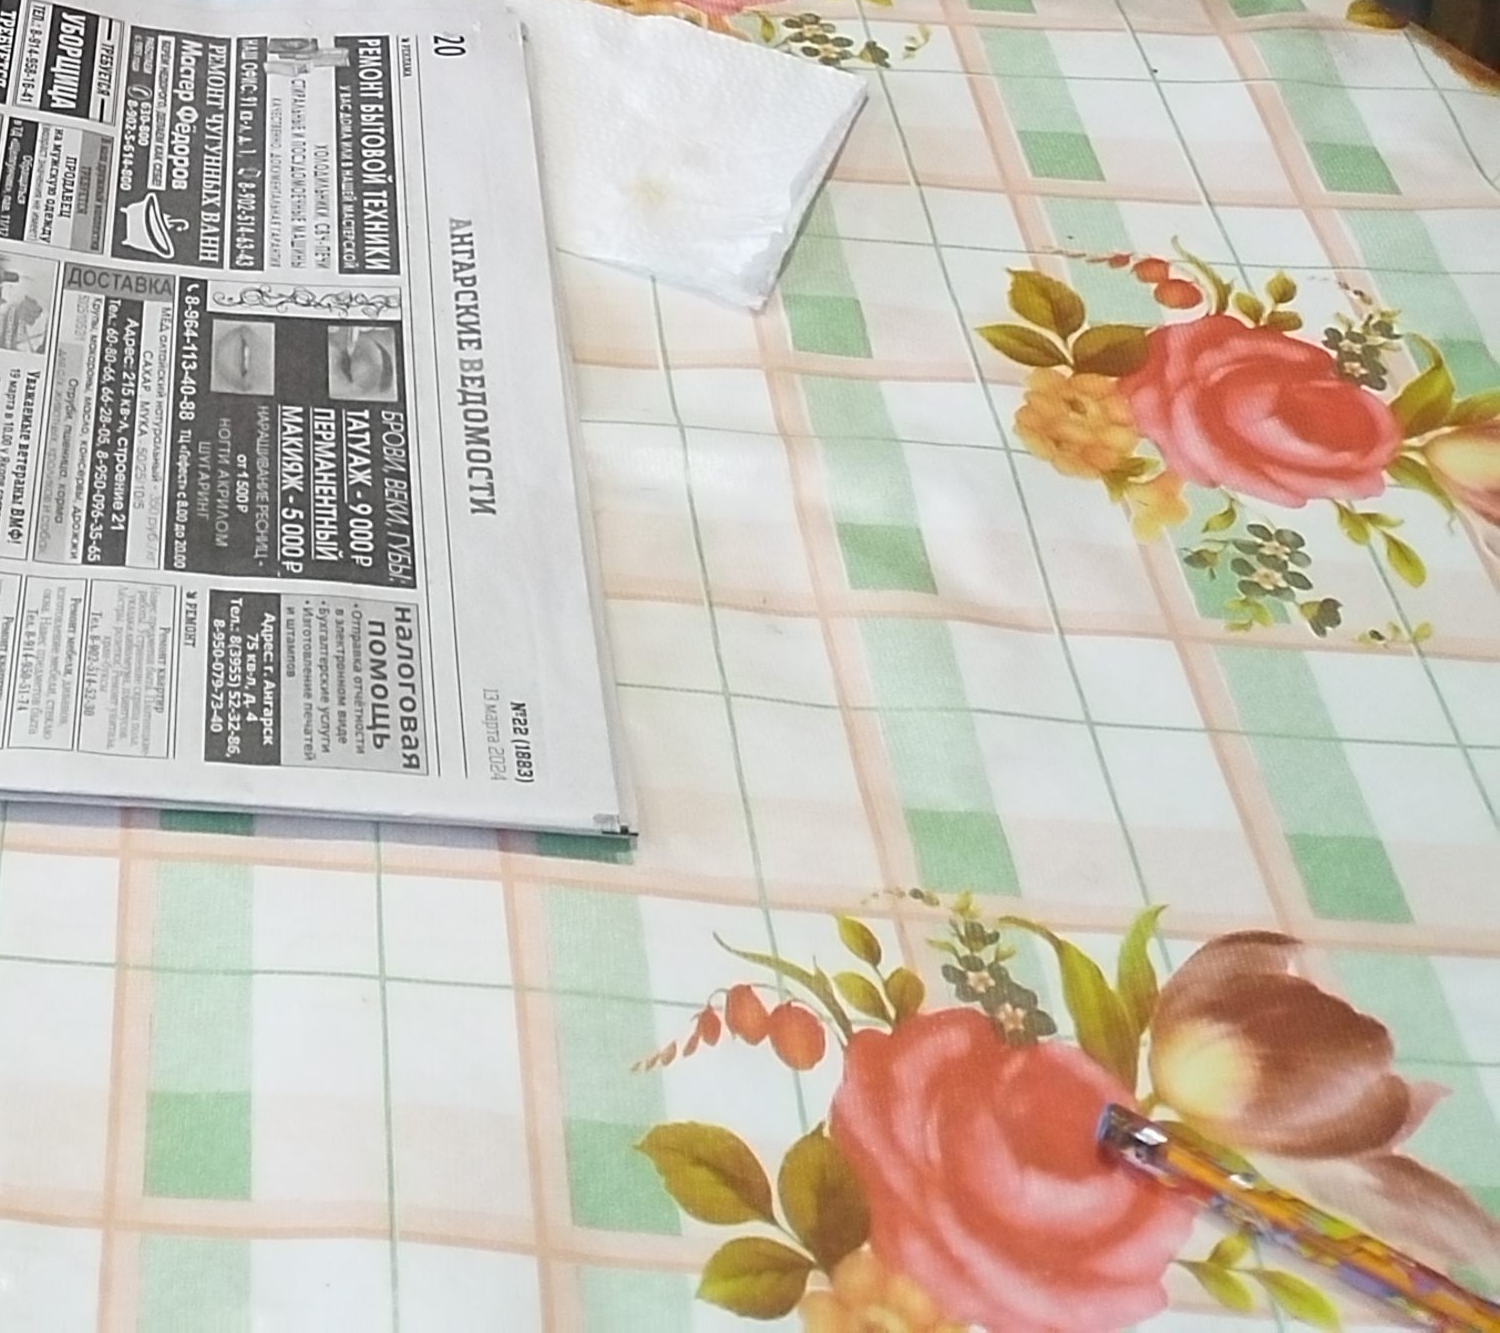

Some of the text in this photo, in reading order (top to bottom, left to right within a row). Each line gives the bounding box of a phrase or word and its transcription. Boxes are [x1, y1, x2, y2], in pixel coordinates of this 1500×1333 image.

[20, 29, 41, 103] 8-914-958-16-41
[48, 12, 86, 108] УБОРЩИЦА
[97, 43, 114, 96] ТРЕБУЕТСЯ
[434, 35, 466, 56] 20
[120, 99, 139, 190] 8-902-5-614-800
[138, 102, 150, 146] 630-800
[169, 39, 203, 189] Мастер Фёдоров
[200, 44, 226, 262] РЕМОНТ ЧУГУННЫХ ВАНН
[358, 39, 392, 270] РЕМОНТ БЫТОВОЙ ТЕХНИКИ
[40, 143, 62, 243] мужскую одежду
[58, 156, 77, 218] ПРОДАВЕЦ
[67, 266, 174, 295] ДОСТАВКА
[4, 381, 17, 410] марта
[119, 318, 139, 369] Адрес:
[120, 372, 135, 396] 215
[449, 217, 496, 515] АНГАРСКИЕ ВЕДОМОСТИ
[8, 371, 41, 544] Уважаемые ветераны ВМФ!
[54, 378, 79, 523] Отруби, пшеница, корма
[68, 297, 102, 559] Крупы, макароны, масло, консервы, дрожжи
[133, 350, 154, 509] САХАР МУКА 50/25/10/5
[149, 335, 169, 482] алтайский натуральный
[174, 295, 199, 568] 8-964-113-40-88 20.00
[281, 405, 304, 490] МАКИЯЖ
[347, 409, 371, 485] ТАТУАЖ
[87, 450, 108, 562] 8-950-096-35-65
[111, 436, 129, 510] строение
[111, 513, 125, 531] 21
[196, 442, 211, 519] ШУГАРИНГ
[215, 418, 230, 547] НОГТИ АКРИЛОМ
[253, 406, 269, 558] НАРАЩИВАНИЕ РЕСНИЦ
[313, 408, 343, 560] ПЕРМАНЕНТНЫЙ
[381, 410, 408, 526] БРОВИ, ВЕКИ,
[184, 602, 197, 648] РЕМОНТ
[210, 619, 224, 733] 8-950-079-73-40
[225, 598, 243, 758] Тел.: 8(3955) 52-32-86,
[246, 633, 259, 650] 75
[260, 613, 276, 746] Адрес: Ангарск
[285, 619, 296, 678] штампов
[317, 608, 331, 753] Бухгалтерские услуги
[335, 619, 348, 744] электронном виде
[302, 608, 316, 761] Изготовление печатей
[350, 611, 366, 755] Отправка отчётности
[367, 620, 391, 749] помощь
[394, 606, 421, 770] налоговая
[482, 688, 507, 781] 13 марта 2024
[509, 702, 535, 783] №22 (1883)
